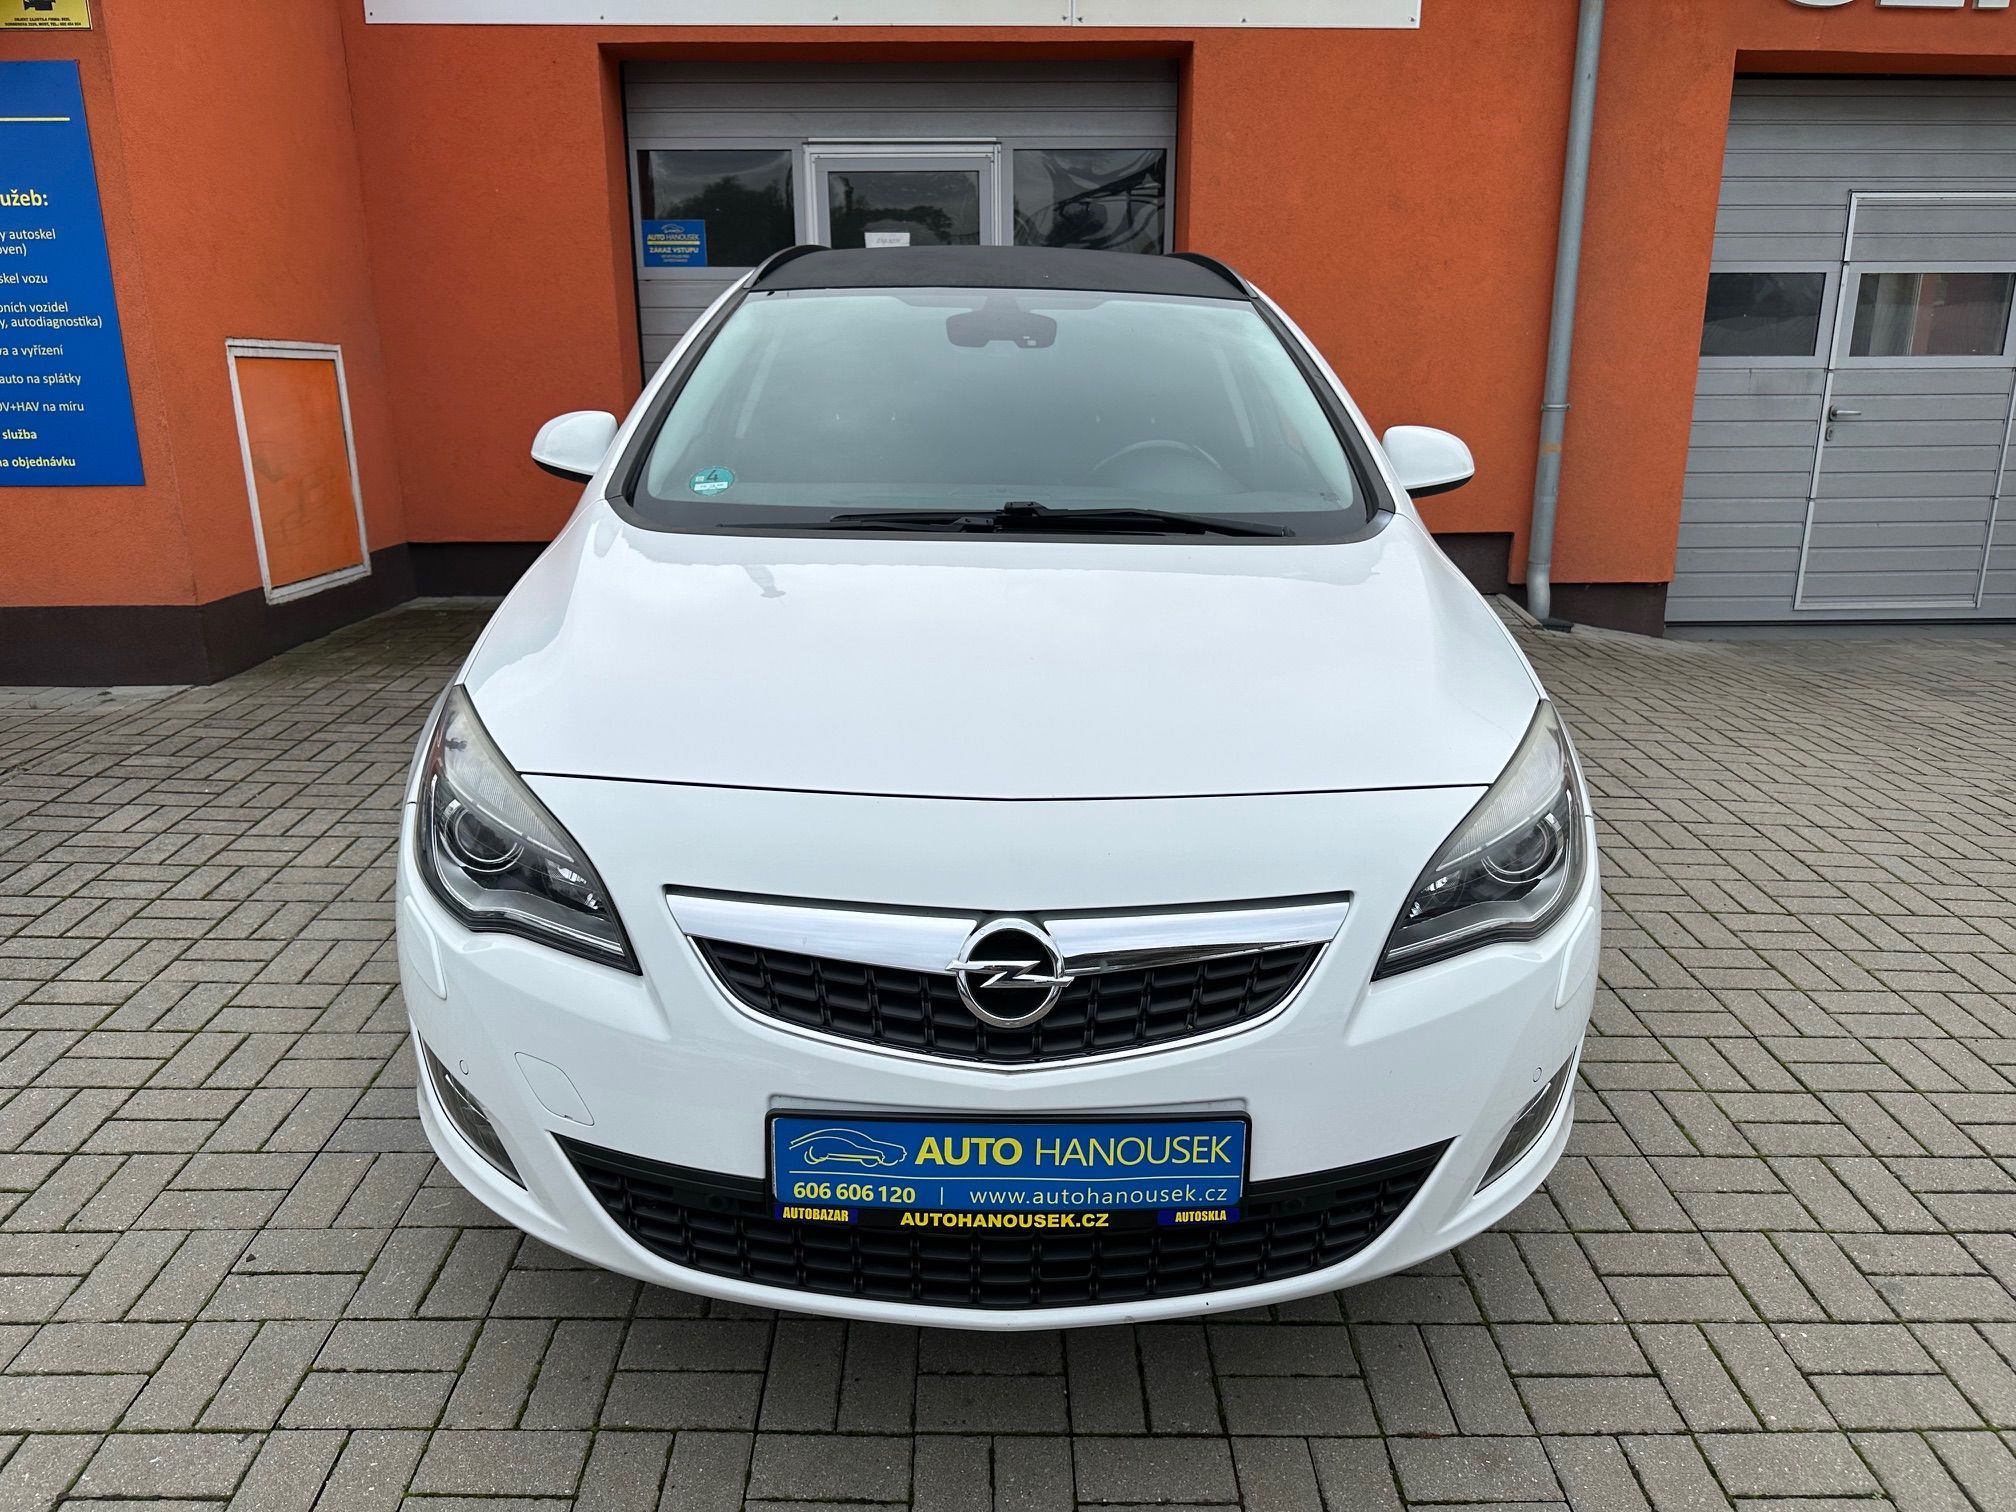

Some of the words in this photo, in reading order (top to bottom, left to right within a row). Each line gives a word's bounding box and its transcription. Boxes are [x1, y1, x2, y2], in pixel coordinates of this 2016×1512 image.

[9, 228, 56, 240] autoskel
[647, 233, 665, 241] AUTO
[666, 233, 700, 241] HANOUSEK
[21, 275, 48, 284] vozu
[29, 301, 69, 313] vozidel
[11, 315, 103, 330] autodiagnostika)
[11, 347, 19, 356] a
[20, 344, 64, 358] vyřízení
[26, 375, 40, 384] na
[42, 372, 81, 386] splátky
[42, 403, 56, 412] na
[59, 400, 85, 412] míru
[2, 428, 38, 440] služba
[11, 456, 76, 469] objednávku
[706, 469, 719, 482] 4
[914, 1136, 1023, 1166] AUTO
[1035, 1135, 1232, 1167] HANOUSEK
[793, 1181, 832, 1199] 606
[836, 1183, 874, 1202] 606
[878, 1185, 916, 1204] 120
[969, 1184, 1228, 1205] www.autohanousek.cz
[782, 1206, 849, 1222] AUTOBAZAR
[900, 1212, 1109, 1228] AUTOHANOUSEK.CZ
[1175, 1209, 1227, 1223] AUTOSKLA
